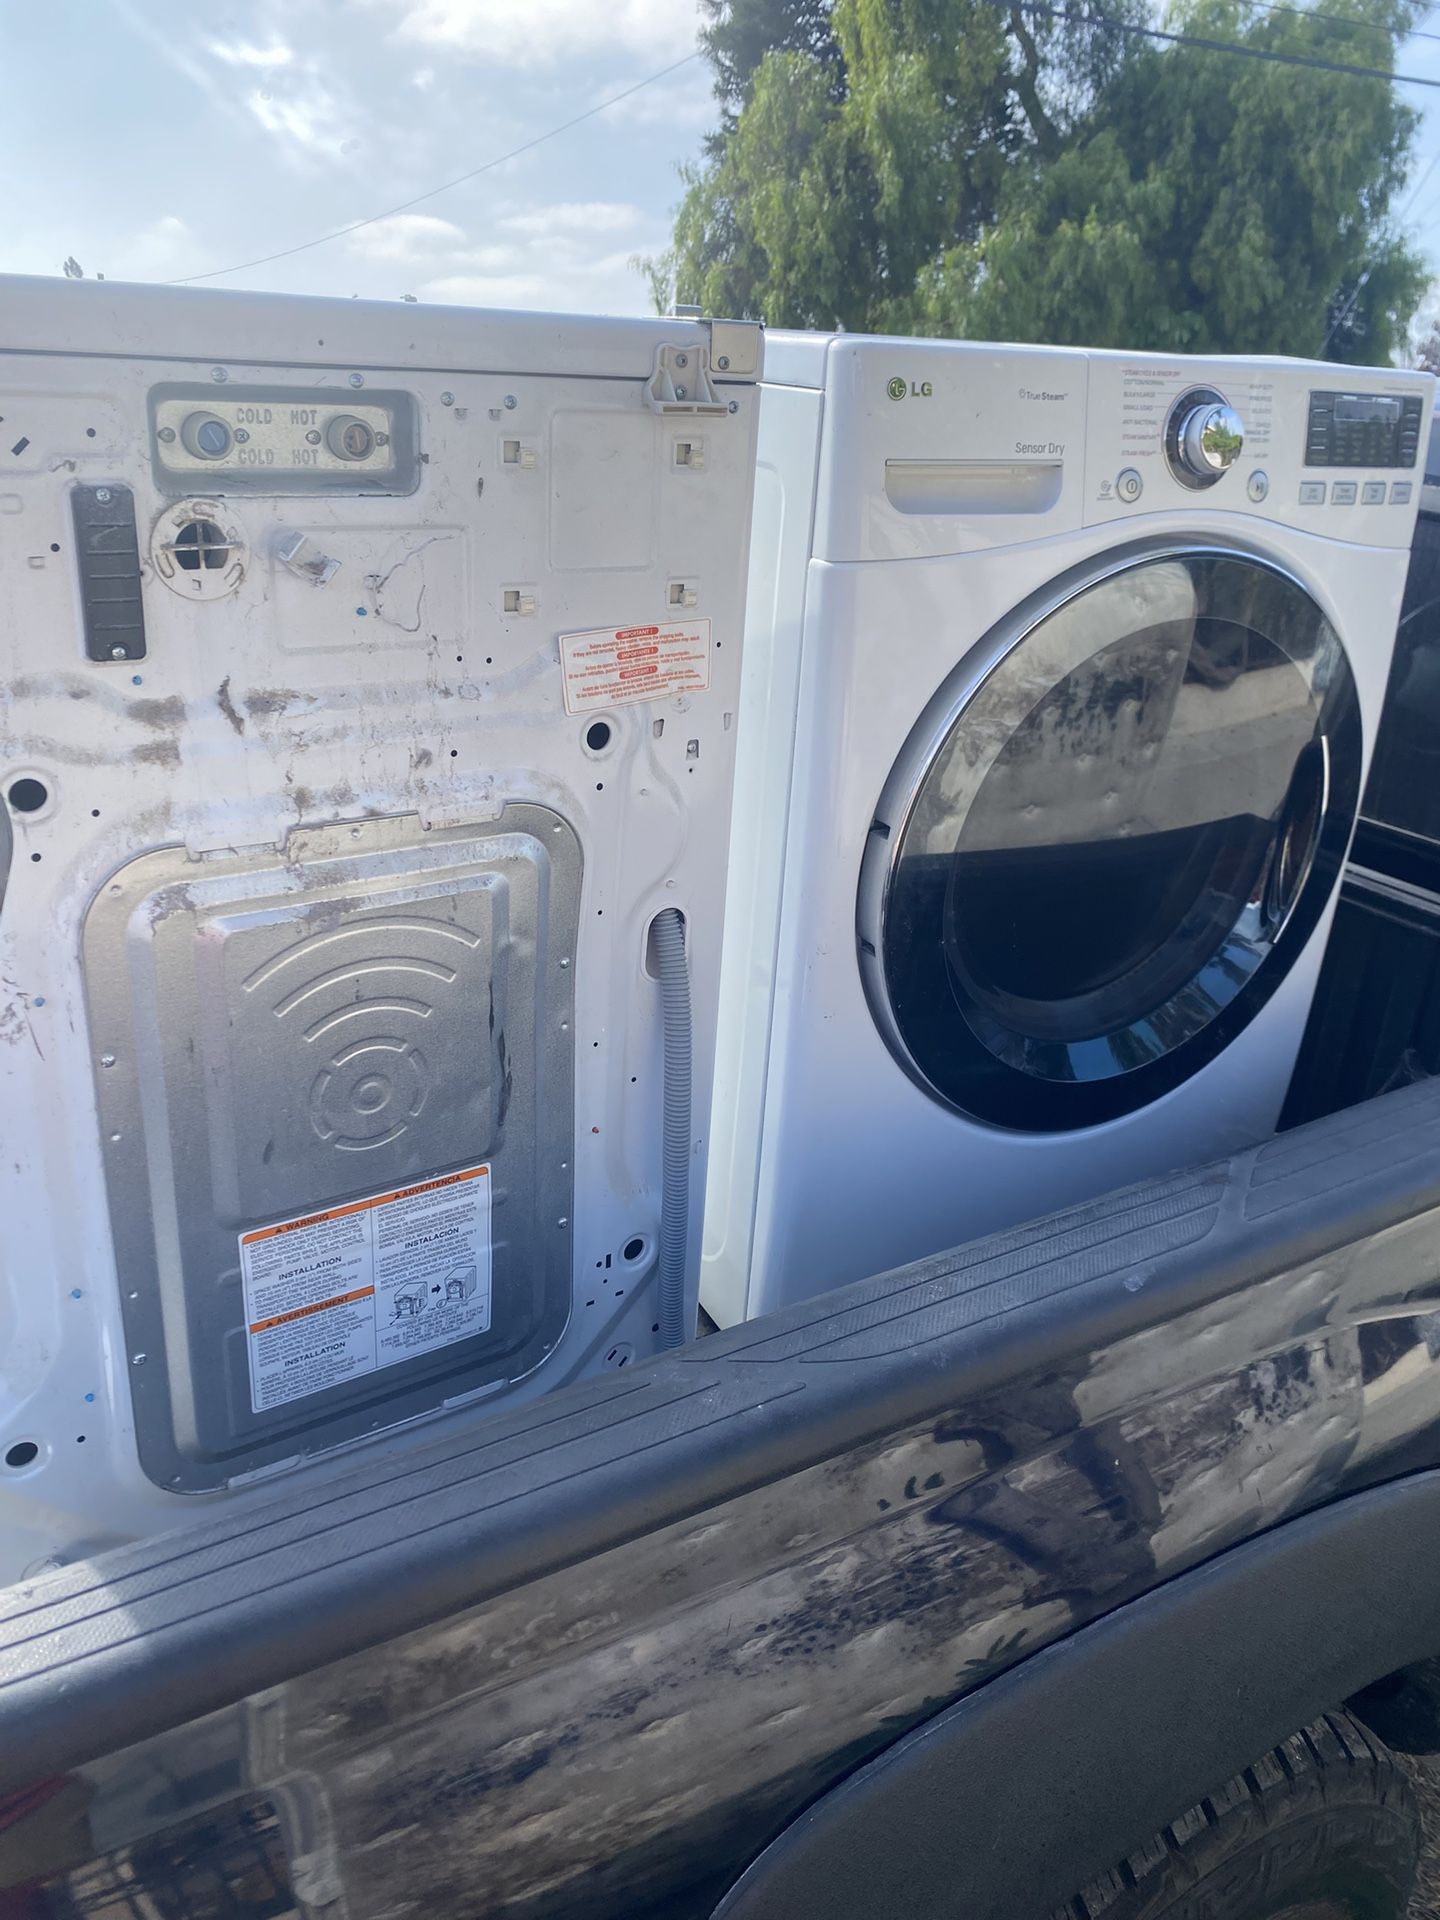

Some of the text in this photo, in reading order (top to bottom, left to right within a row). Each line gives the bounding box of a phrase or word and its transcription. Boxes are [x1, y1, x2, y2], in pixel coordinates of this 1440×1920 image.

[911, 382, 932, 396] LG
[236, 408, 316, 426] COLD HOT
[238, 448, 319, 465] COLD HOT
[1015, 442, 1066, 456] Sensor Dry
[402, 1176, 460, 1198] ADVERTENCIA
[286, 1213, 330, 1232] WARNING
[404, 1226, 460, 1249] INSTALACIÓN
[278, 1256, 342, 1280] INSTALLATION
[277, 1296, 349, 1324] AVERTISSEMENT
[284, 1341, 346, 1366] INSTALLATION
